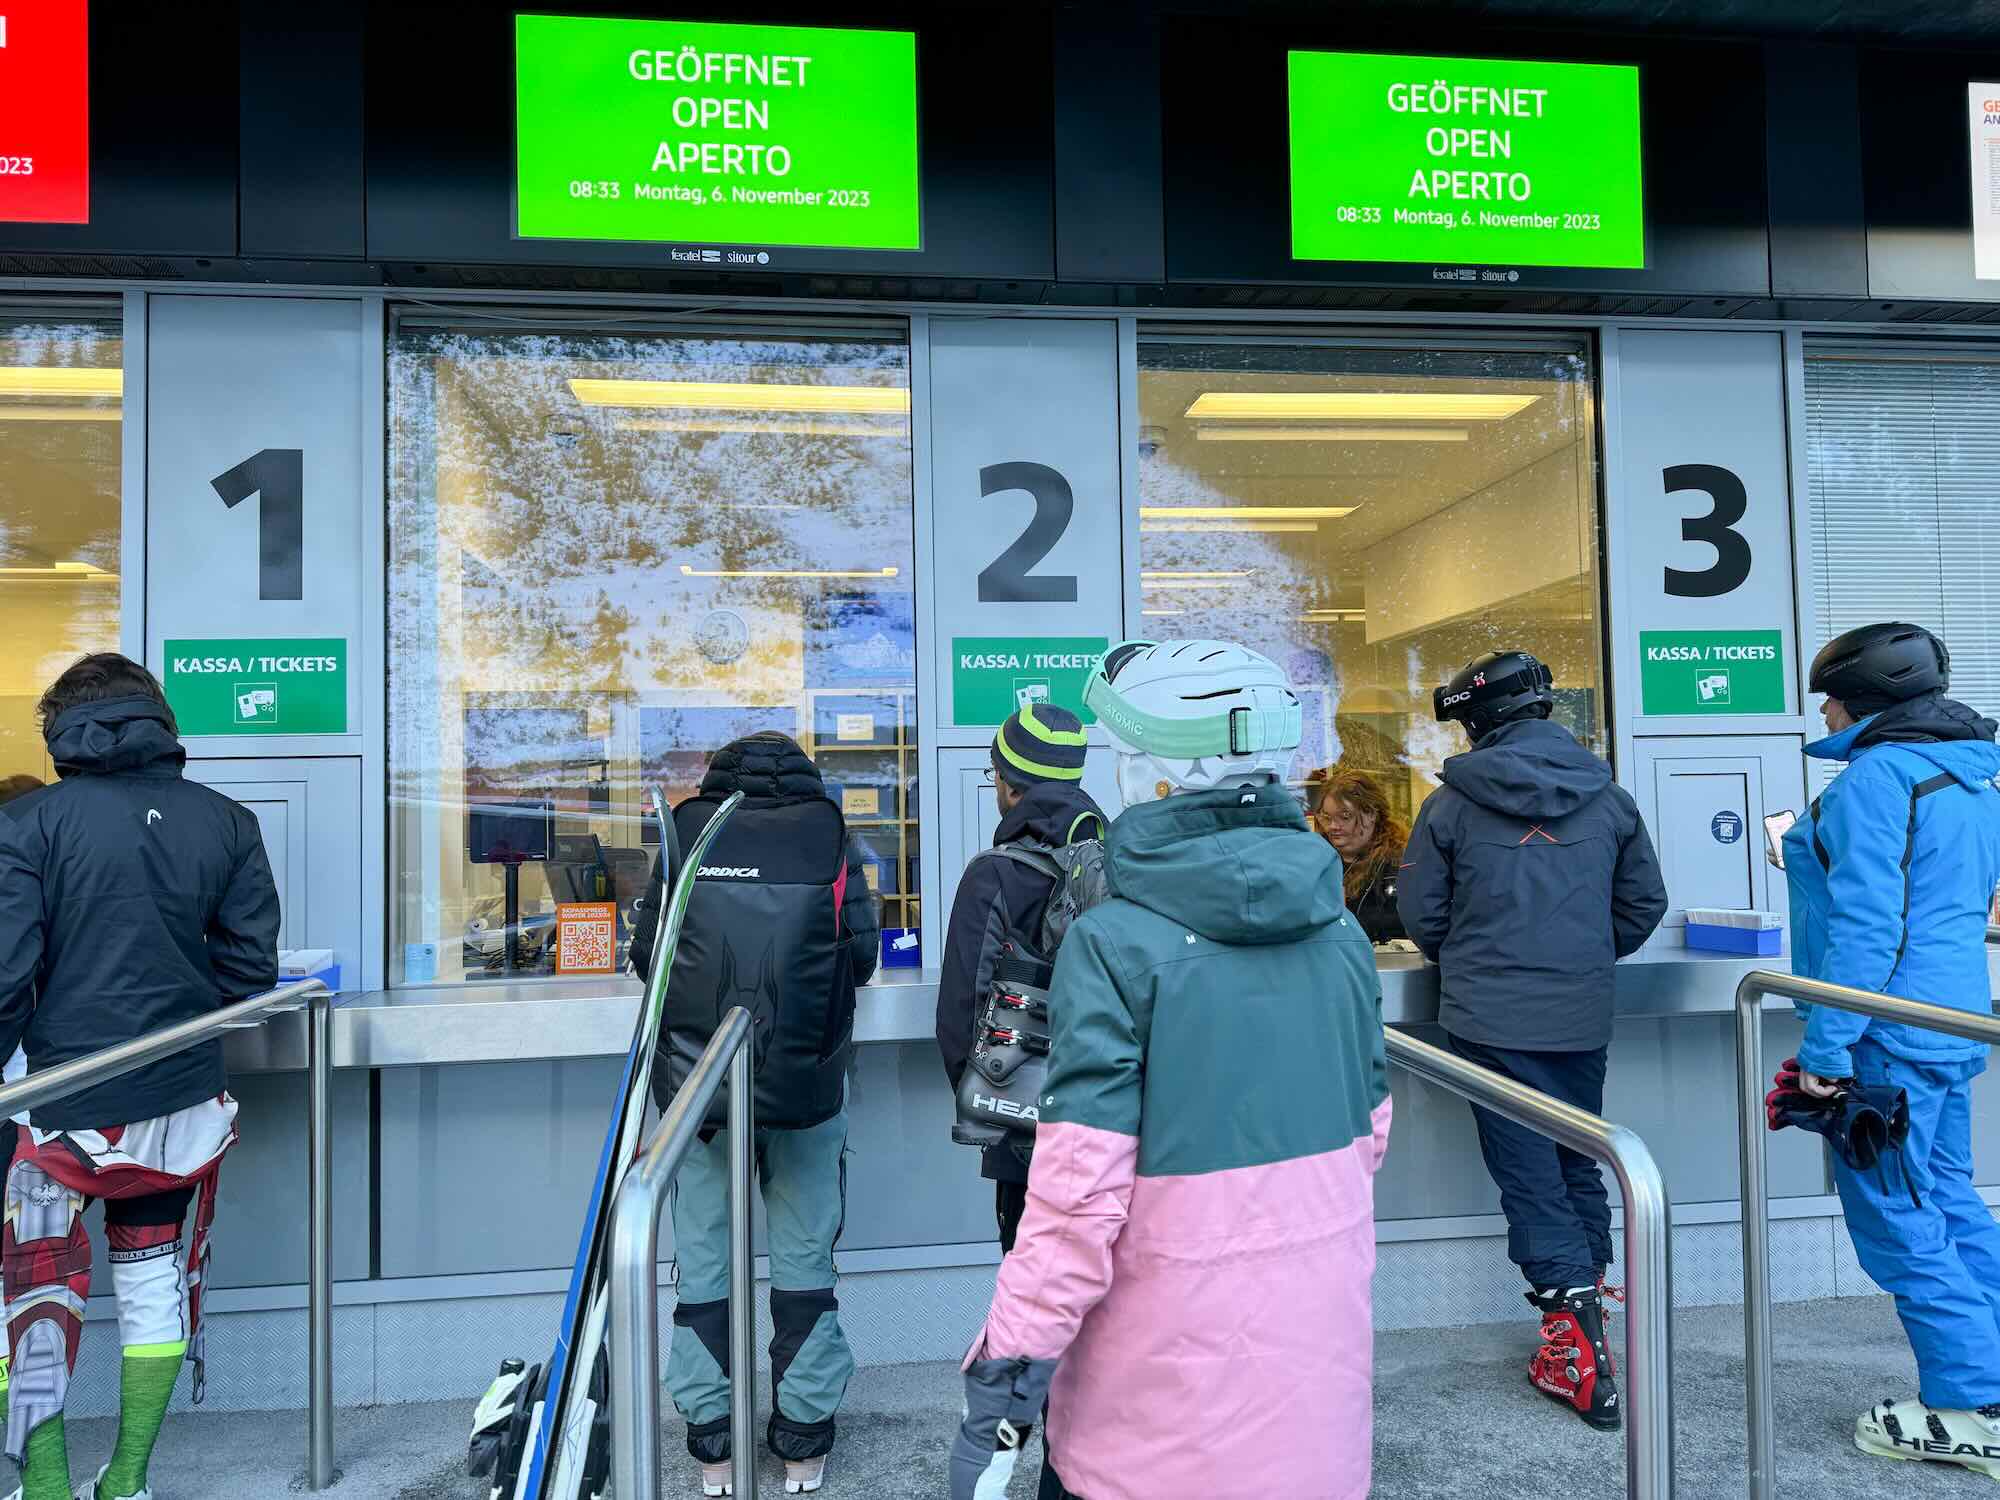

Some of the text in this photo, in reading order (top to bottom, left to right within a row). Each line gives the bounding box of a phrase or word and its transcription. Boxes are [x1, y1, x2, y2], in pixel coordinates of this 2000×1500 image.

[628, 46, 811, 86] GEÖFFNET
[672, 96, 769, 129] OPEN
[1387, 80, 1548, 118] GEÖFFNET
[1984, 100, 2000, 113] GE
[1426, 127, 1511, 159] OPEN
[0, 157, 33, 175] 023
[651, 142, 792, 176] APERTO
[569, 181, 871, 207] 08:33 Montag, 6. November 2023
[1408, 169, 1532, 202] APERTO
[1336, 207, 1601, 230] 08:33 Montag, 6. November 2023
[671, 248, 757, 263] feratel sitour
[210, 449, 303, 600] 1
[977, 461, 1078, 602] 2
[1662, 464, 1752, 597] 3
[173, 656, 337, 673] KASSA / TICKETS
[961, 654, 1021, 669] KASSA
[1024, 654, 1031, 669] /
[1647, 645, 1776, 661] KASSA / TICKETS
[1443, 691, 1471, 707] POC
[1103, 704, 1144, 736] ATOMIC
[696, 866, 760, 878] ORDICA
[972, 1094, 1040, 1121] HEA
